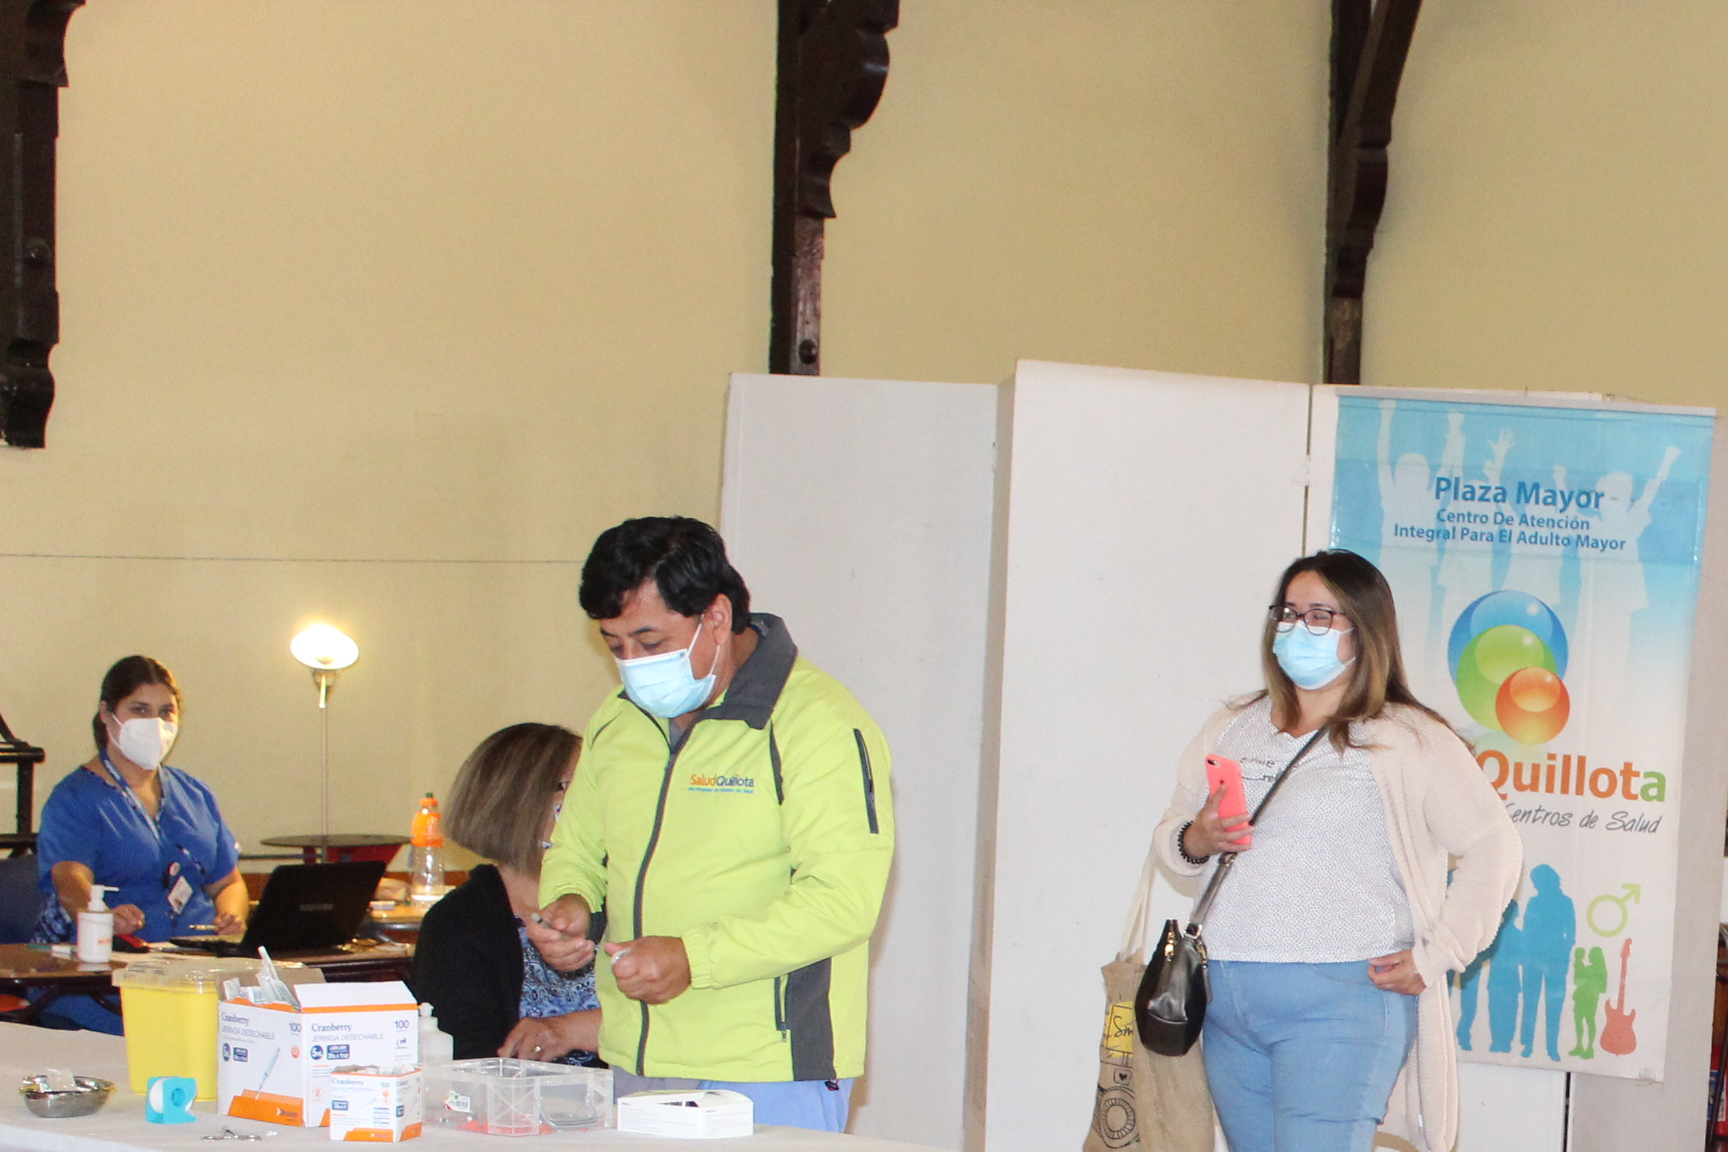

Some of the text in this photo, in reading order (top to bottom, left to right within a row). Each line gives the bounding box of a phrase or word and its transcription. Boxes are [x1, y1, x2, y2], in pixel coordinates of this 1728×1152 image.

[1435, 477, 1605, 514] Plaza Mayor
[1437, 508, 1590, 531] Centro De Atención
[1394, 524, 1627, 552] Integral Para El Adulto Mayor
[1476, 749, 1667, 803] Quillota
[1579, 809, 1598, 829] de
[1605, 810, 1663, 834] Salud
[221, 1012, 250, 1027] Cranberry
[289, 1022, 302, 1033] 100
[311, 1022, 353, 1033] Cranberry
[394, 1019, 410, 1030] 100
